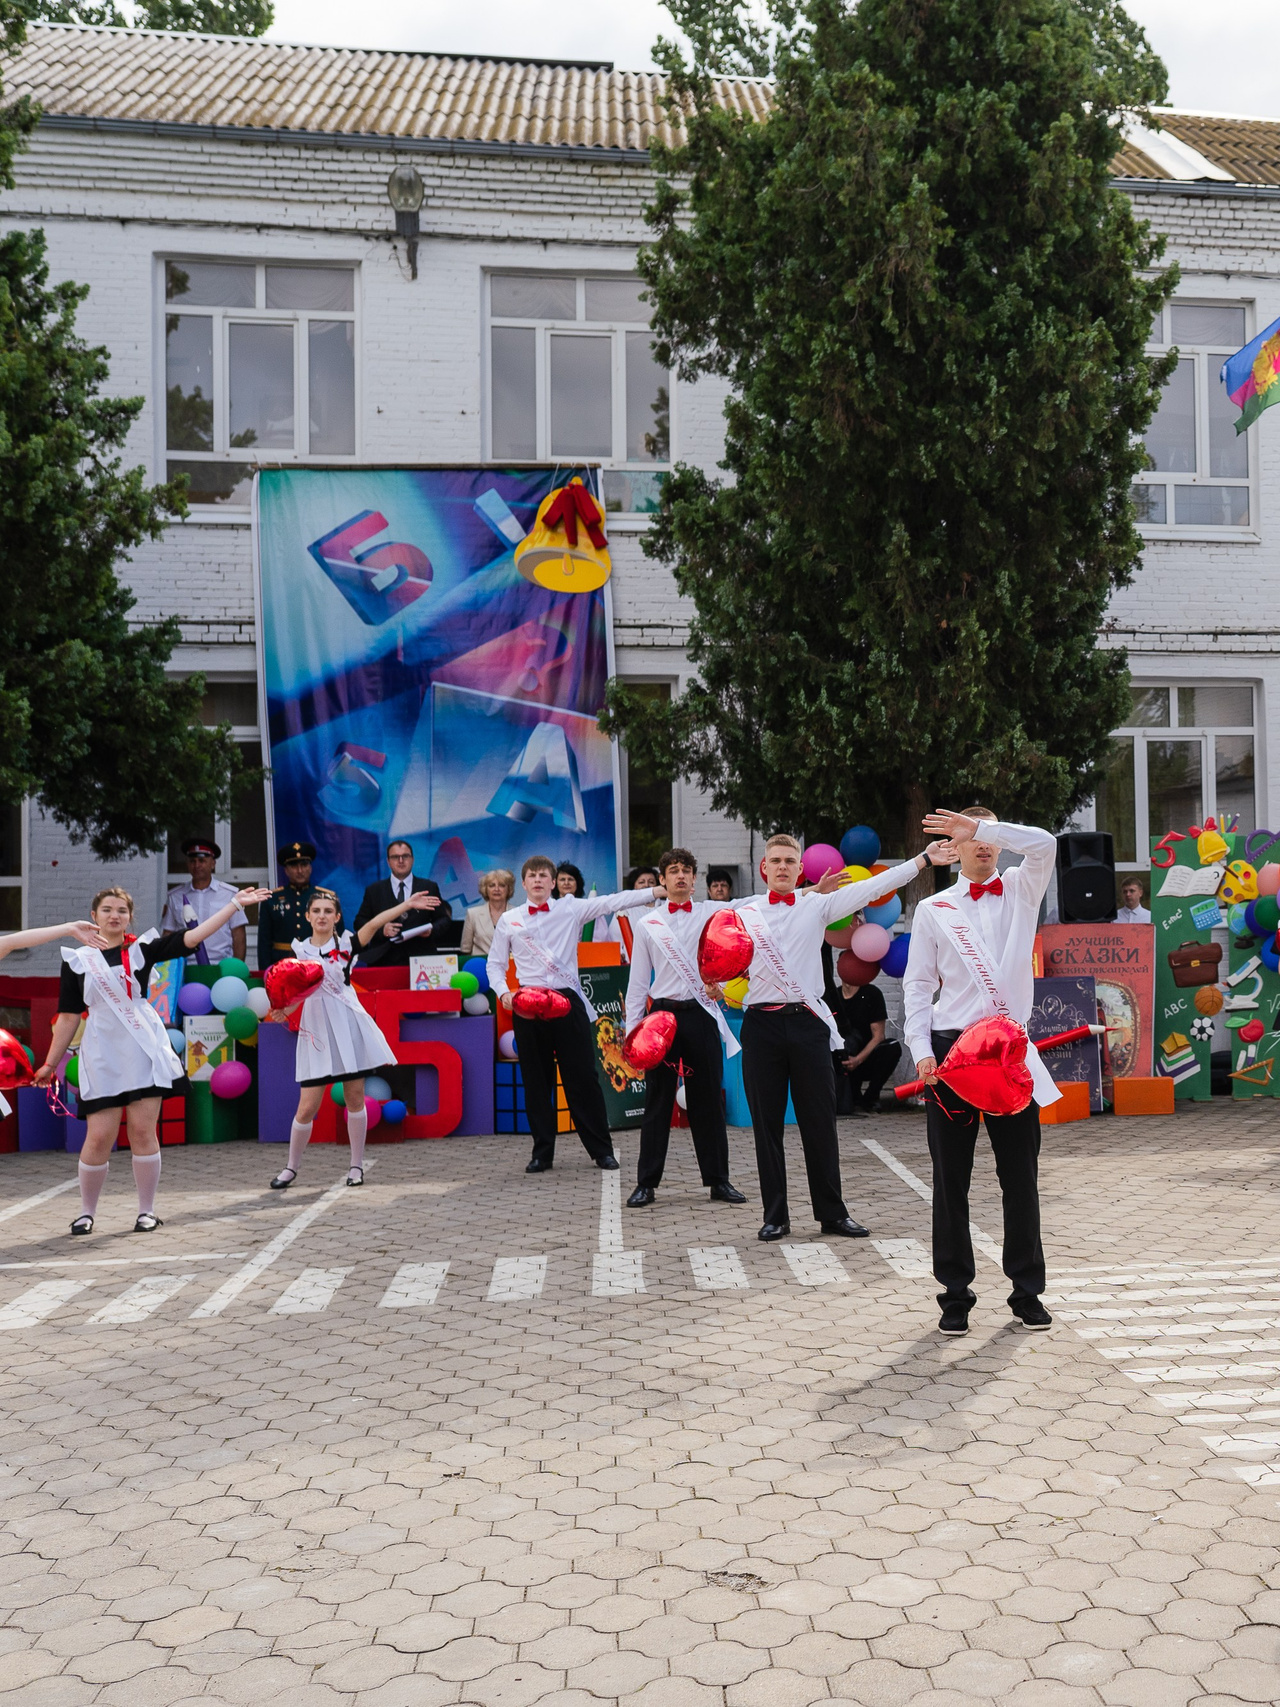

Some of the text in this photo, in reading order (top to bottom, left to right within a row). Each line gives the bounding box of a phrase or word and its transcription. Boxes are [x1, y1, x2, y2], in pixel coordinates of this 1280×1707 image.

[1151, 830, 1187, 869] 5
[748, 915, 789, 978] Выпускник
[1050, 948, 1141, 965] СКАЗКИ
[947, 914, 999, 996] Выпускник
[992, 999, 1010, 1016] 20
[1088, 965, 1150, 977] писателей
[1163, 997, 1189, 1019] ABC
